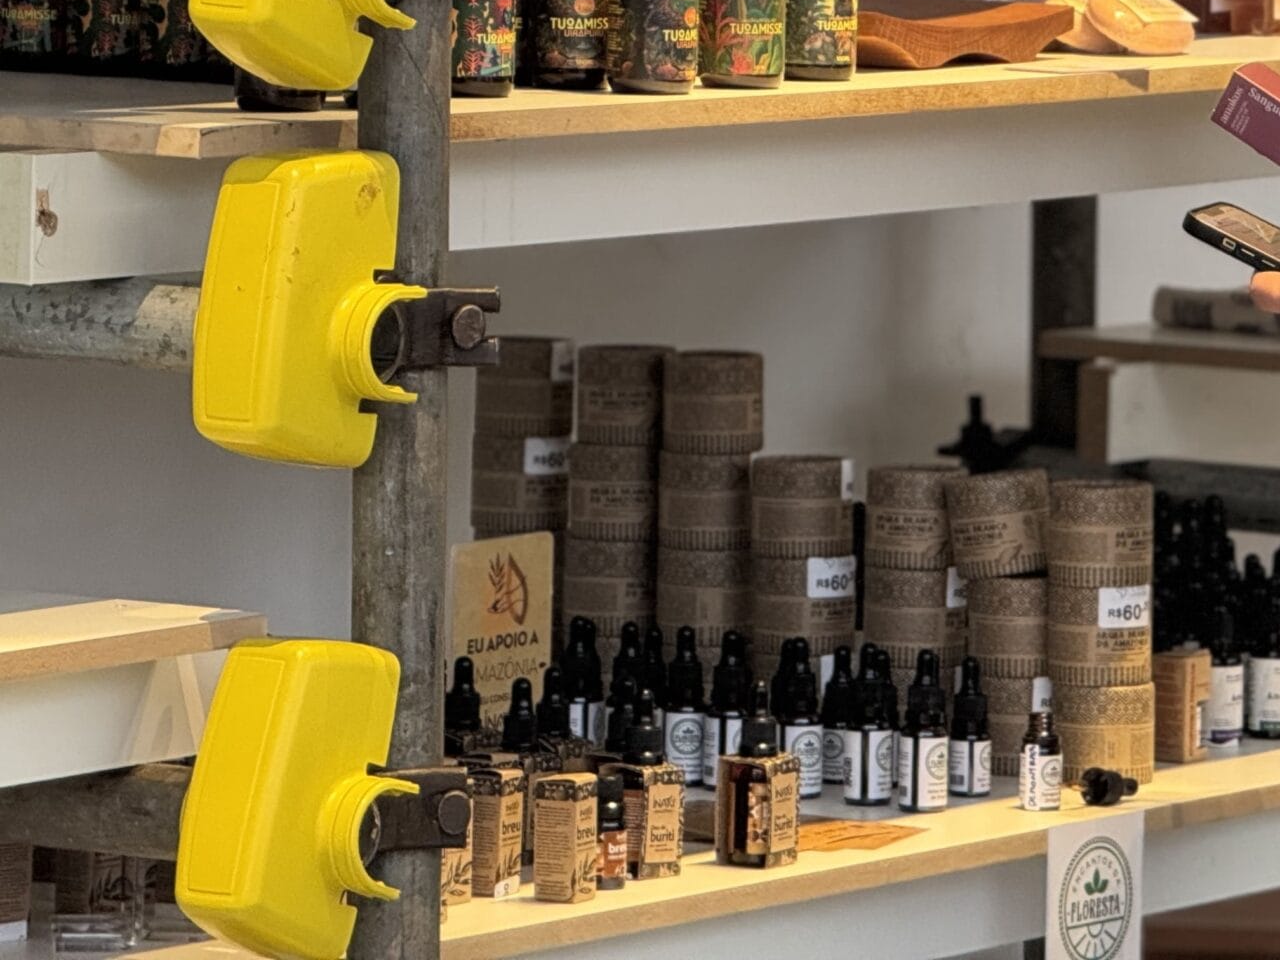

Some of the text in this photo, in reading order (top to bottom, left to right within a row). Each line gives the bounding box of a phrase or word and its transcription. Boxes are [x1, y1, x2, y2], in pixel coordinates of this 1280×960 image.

[467, 630, 538, 654] EU APOIO A
[502, 821, 521, 835] breu
[576, 826, 595, 840] breu
[650, 827, 675, 842] buriti
[608, 843, 627, 855] bre
[1070, 893, 1121, 924] FLORESTA
